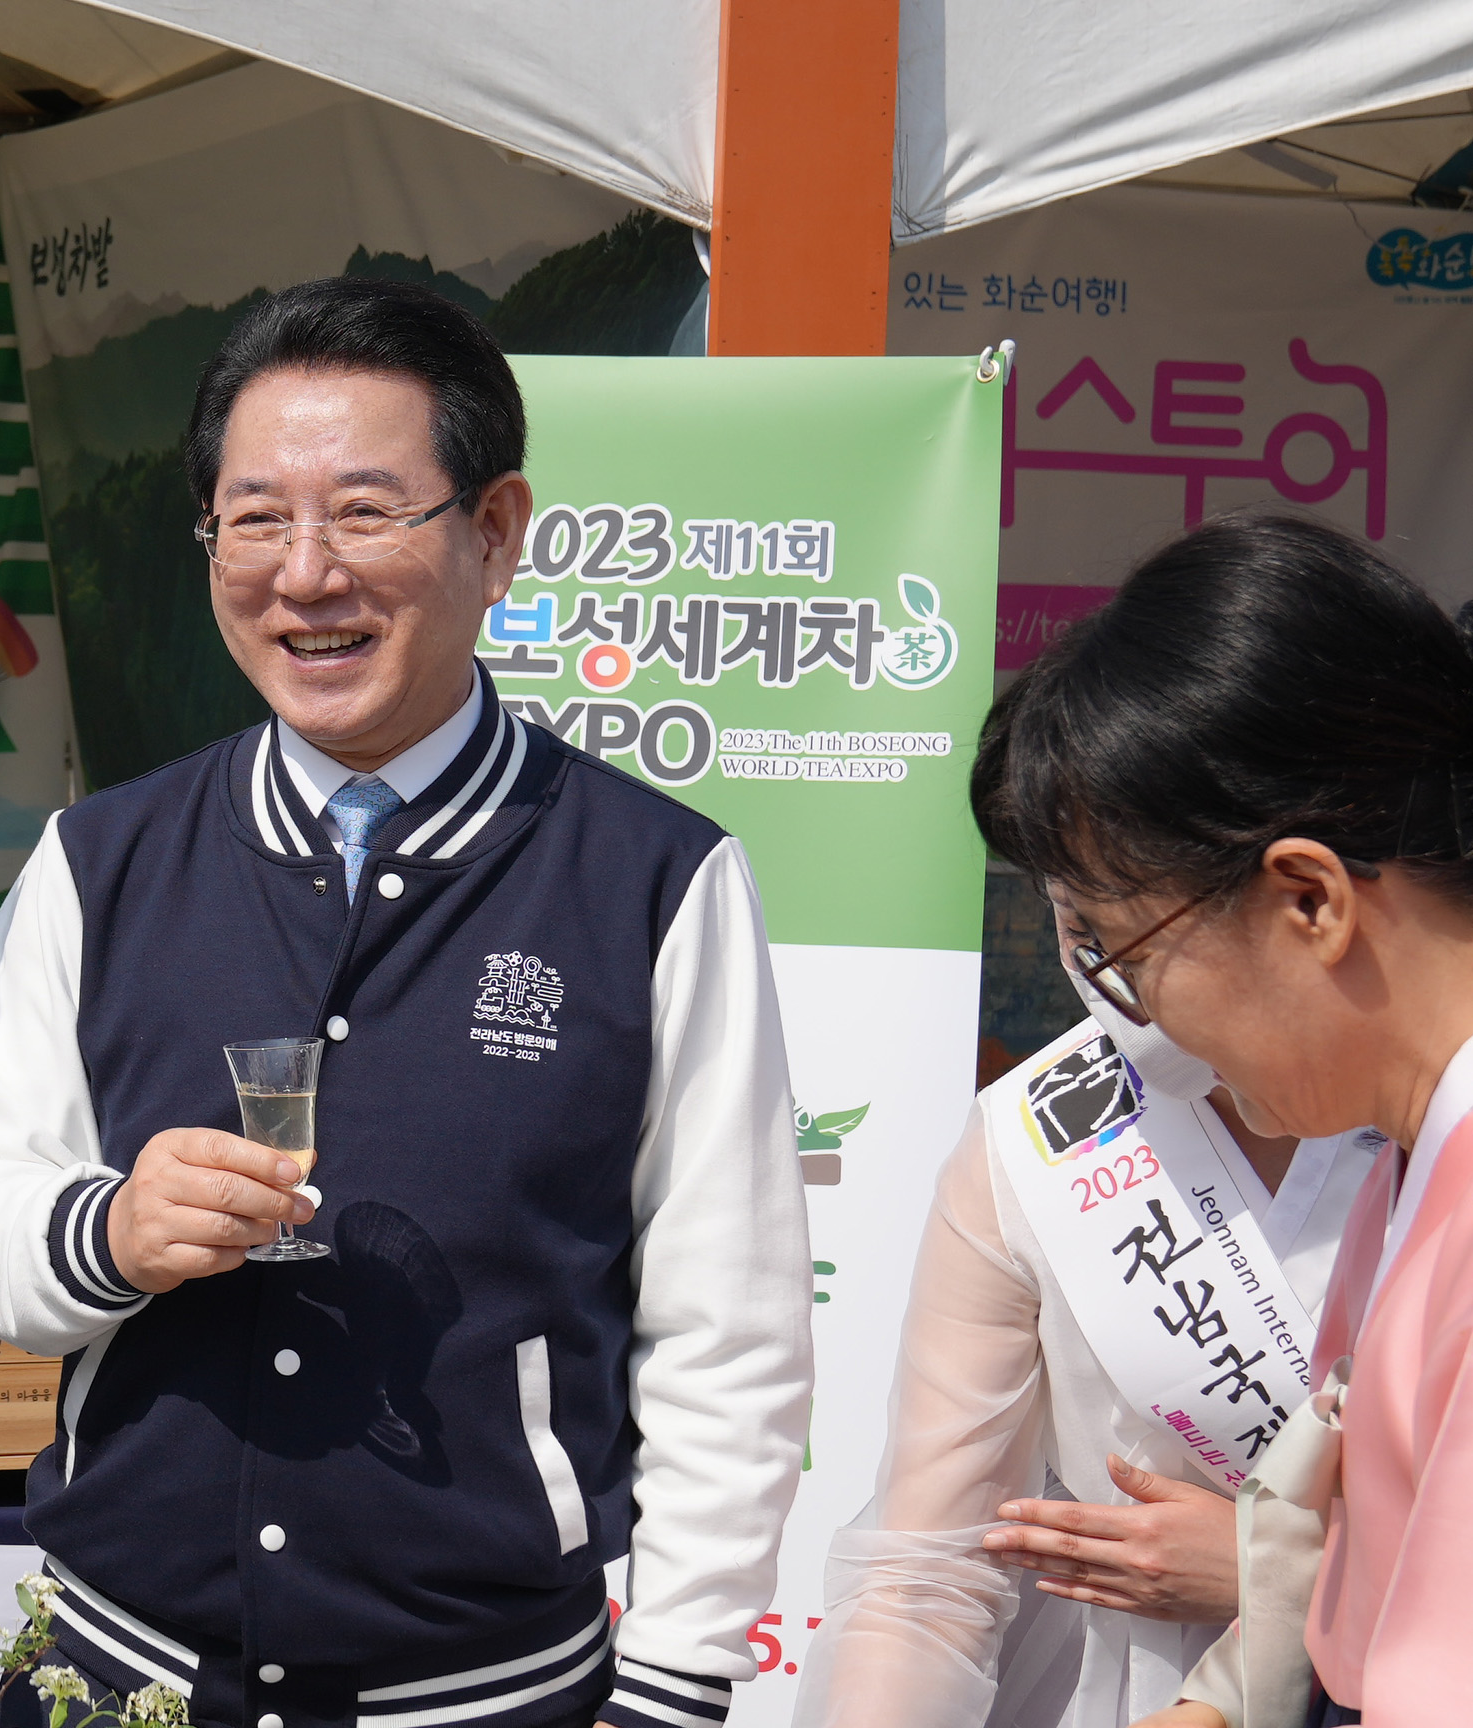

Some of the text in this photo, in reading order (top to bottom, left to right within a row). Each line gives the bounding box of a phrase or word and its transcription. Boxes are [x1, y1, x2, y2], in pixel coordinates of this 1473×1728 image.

[903, 272, 1129, 317] 있는 화순여행!
[1000, 337, 1388, 541] 스투어
[512, 508, 830, 581] 023 제11회
[489, 597, 885, 688] 보성세계차
[502, 701, 711, 781] XPO
[722, 732, 948, 753] 2023 The 11th BOSEONG
[722, 758, 905, 779] WORLD TEA EXPO
[482, 1044, 541, 1061] 2022-2023
[1070, 1144, 1161, 1213] 2023
[1191, 1184, 1261, 1294] Jeonnam
